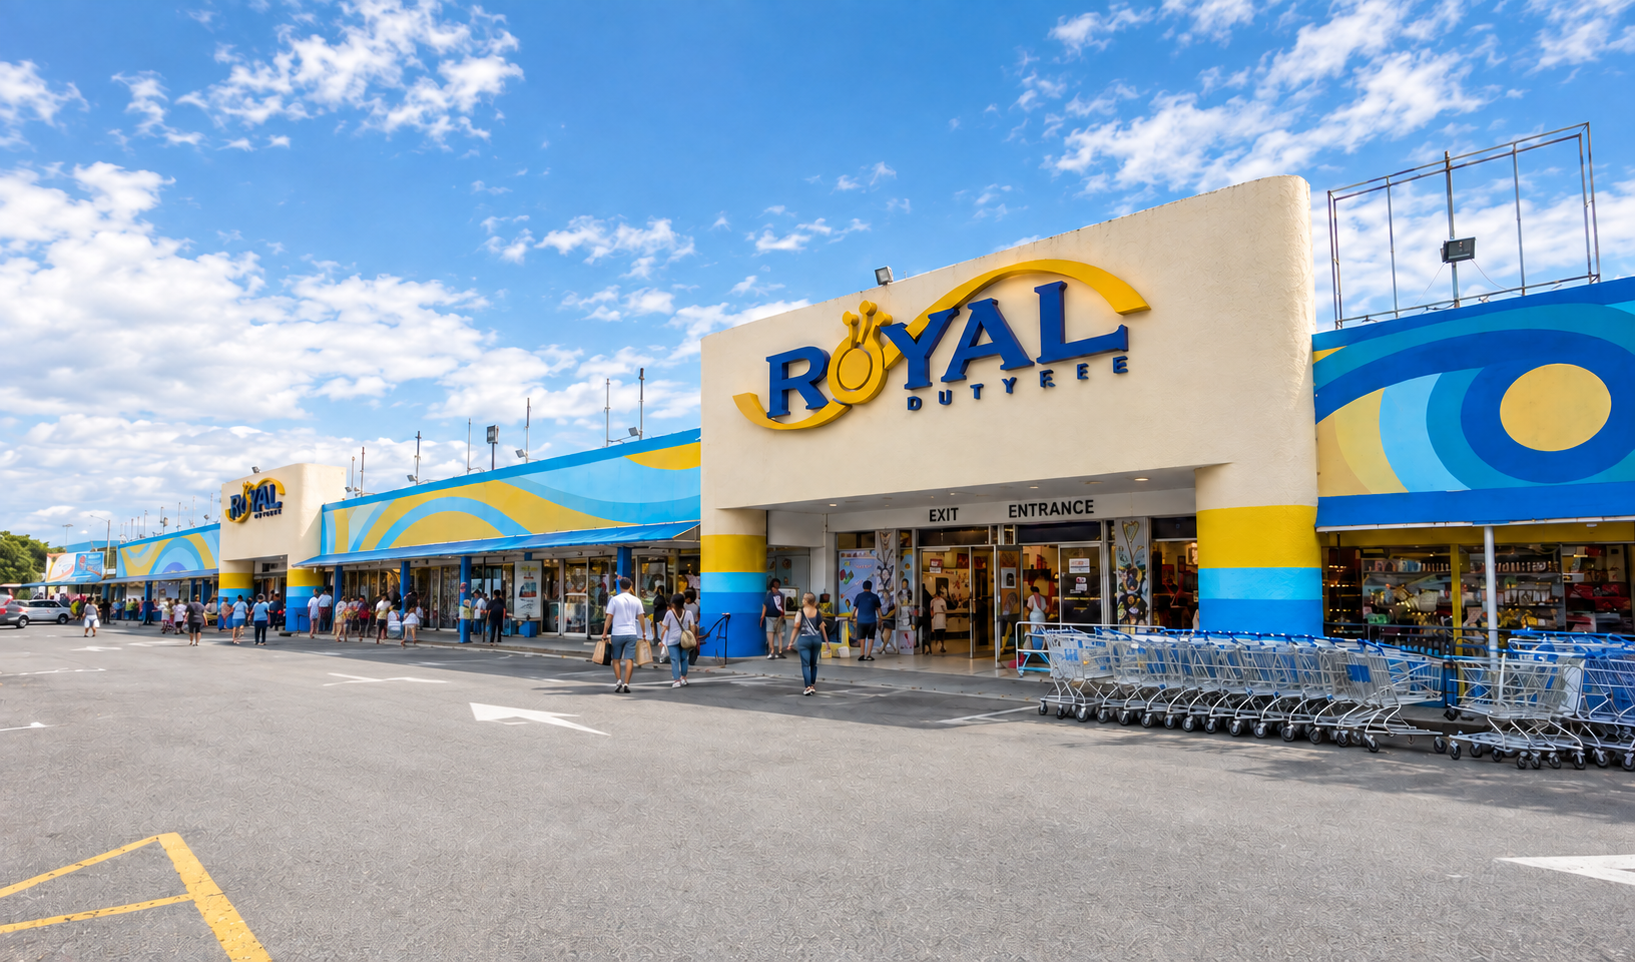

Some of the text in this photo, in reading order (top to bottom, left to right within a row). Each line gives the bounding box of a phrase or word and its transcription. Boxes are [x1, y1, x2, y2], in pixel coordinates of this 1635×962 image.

[766, 280, 1129, 419] ROYAL
[230, 483, 283, 520] ROYAL
[929, 507, 959, 522] EXIT
[1008, 499, 1094, 518] ENTRANCE
